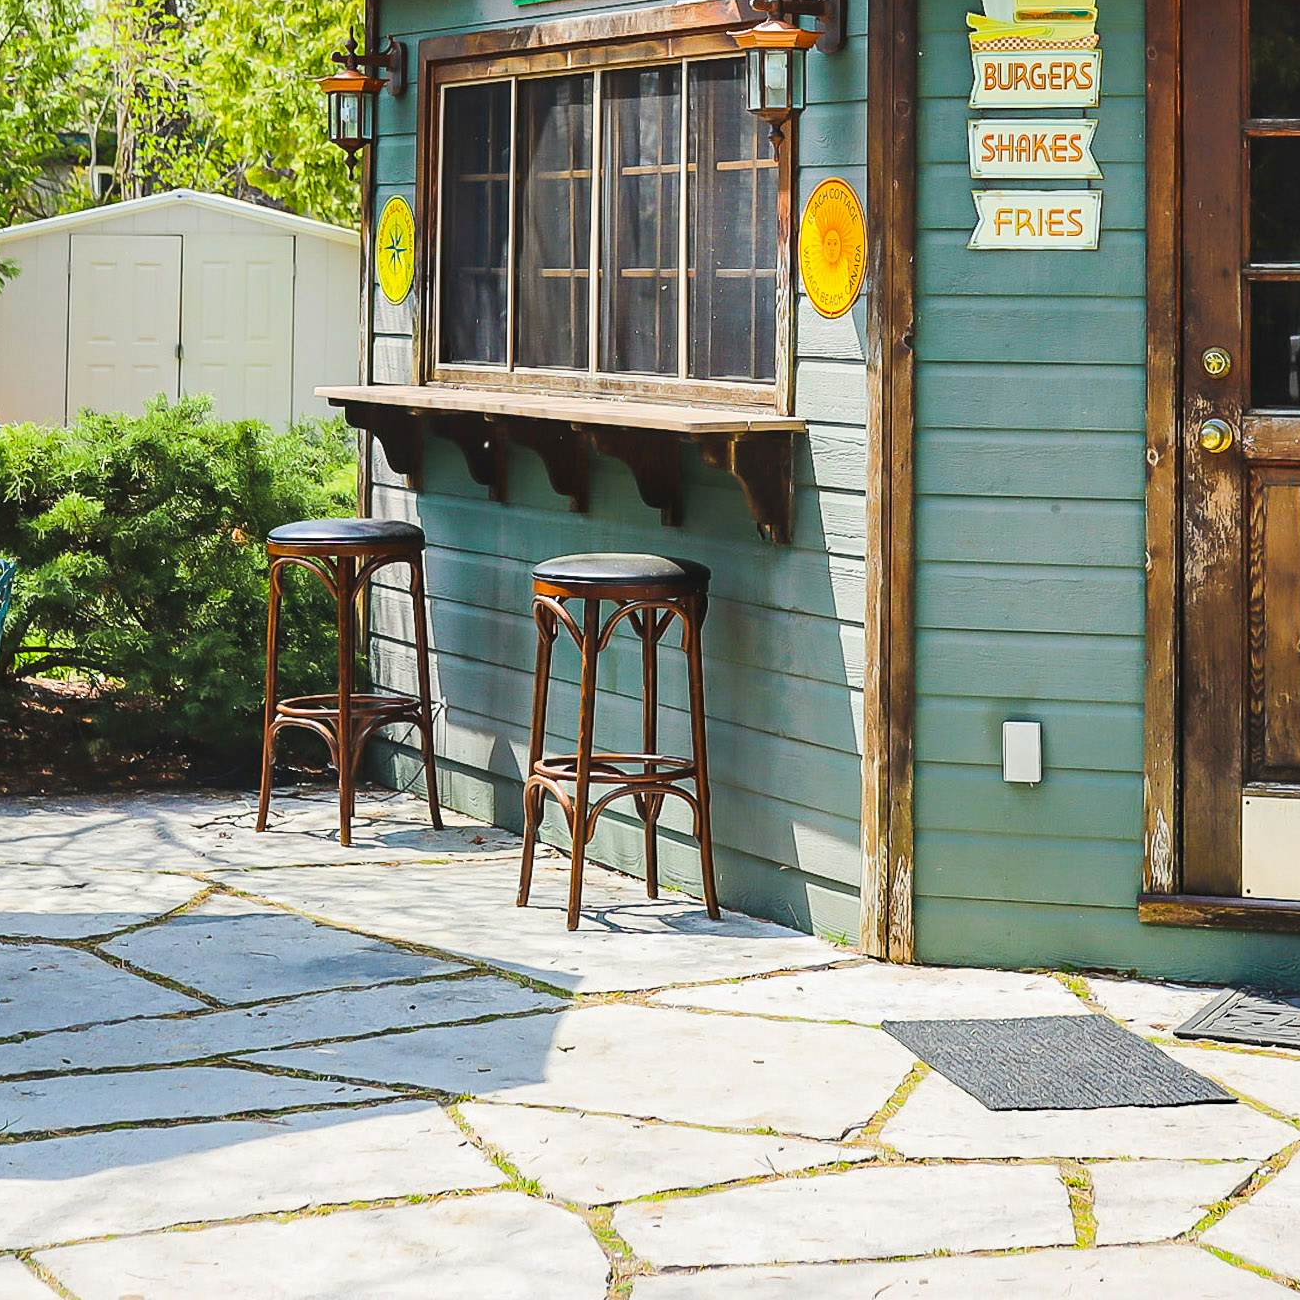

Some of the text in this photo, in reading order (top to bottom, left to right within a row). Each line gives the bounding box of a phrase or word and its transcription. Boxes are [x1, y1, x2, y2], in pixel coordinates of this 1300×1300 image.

[983, 61, 1094, 91] BURGERS
[981, 133, 1083, 163] SHAKES
[808, 187, 859, 226] BEACH COTTAGE
[993, 207, 1083, 238] FRIES
[844, 244, 862, 295] CANADA
